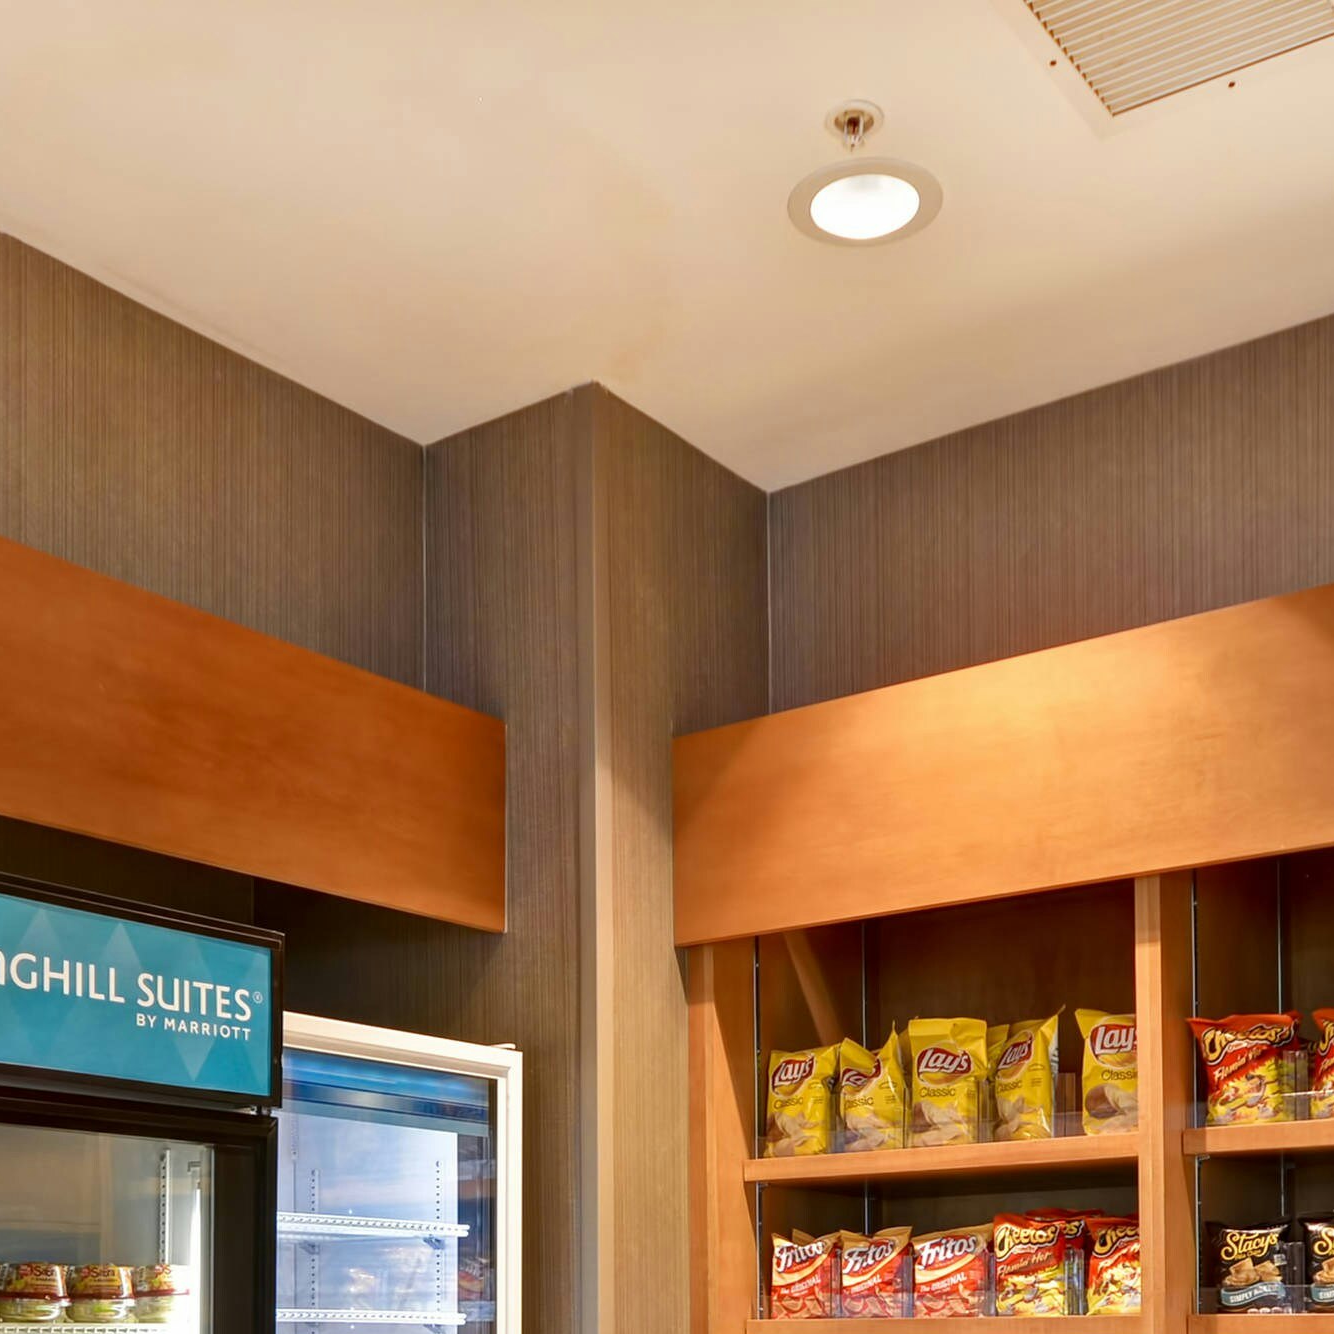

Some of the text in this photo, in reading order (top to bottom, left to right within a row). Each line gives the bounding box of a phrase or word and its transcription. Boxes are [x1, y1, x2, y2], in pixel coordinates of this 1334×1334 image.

[136, 971, 254, 1023] SUITES
[135, 1012, 253, 1041] BY MARRIOTT
[775, 1055, 816, 1086] Lay's
[918, 1049, 972, 1074] Lay's
[919, 1087, 956, 1098] Classic
[774, 1239, 825, 1273] Fritos
[919, 1235, 978, 1270] Fritos
[995, 1223, 1058, 1260] Cheetos
[1221, 1231, 1279, 1261] Stacy's
